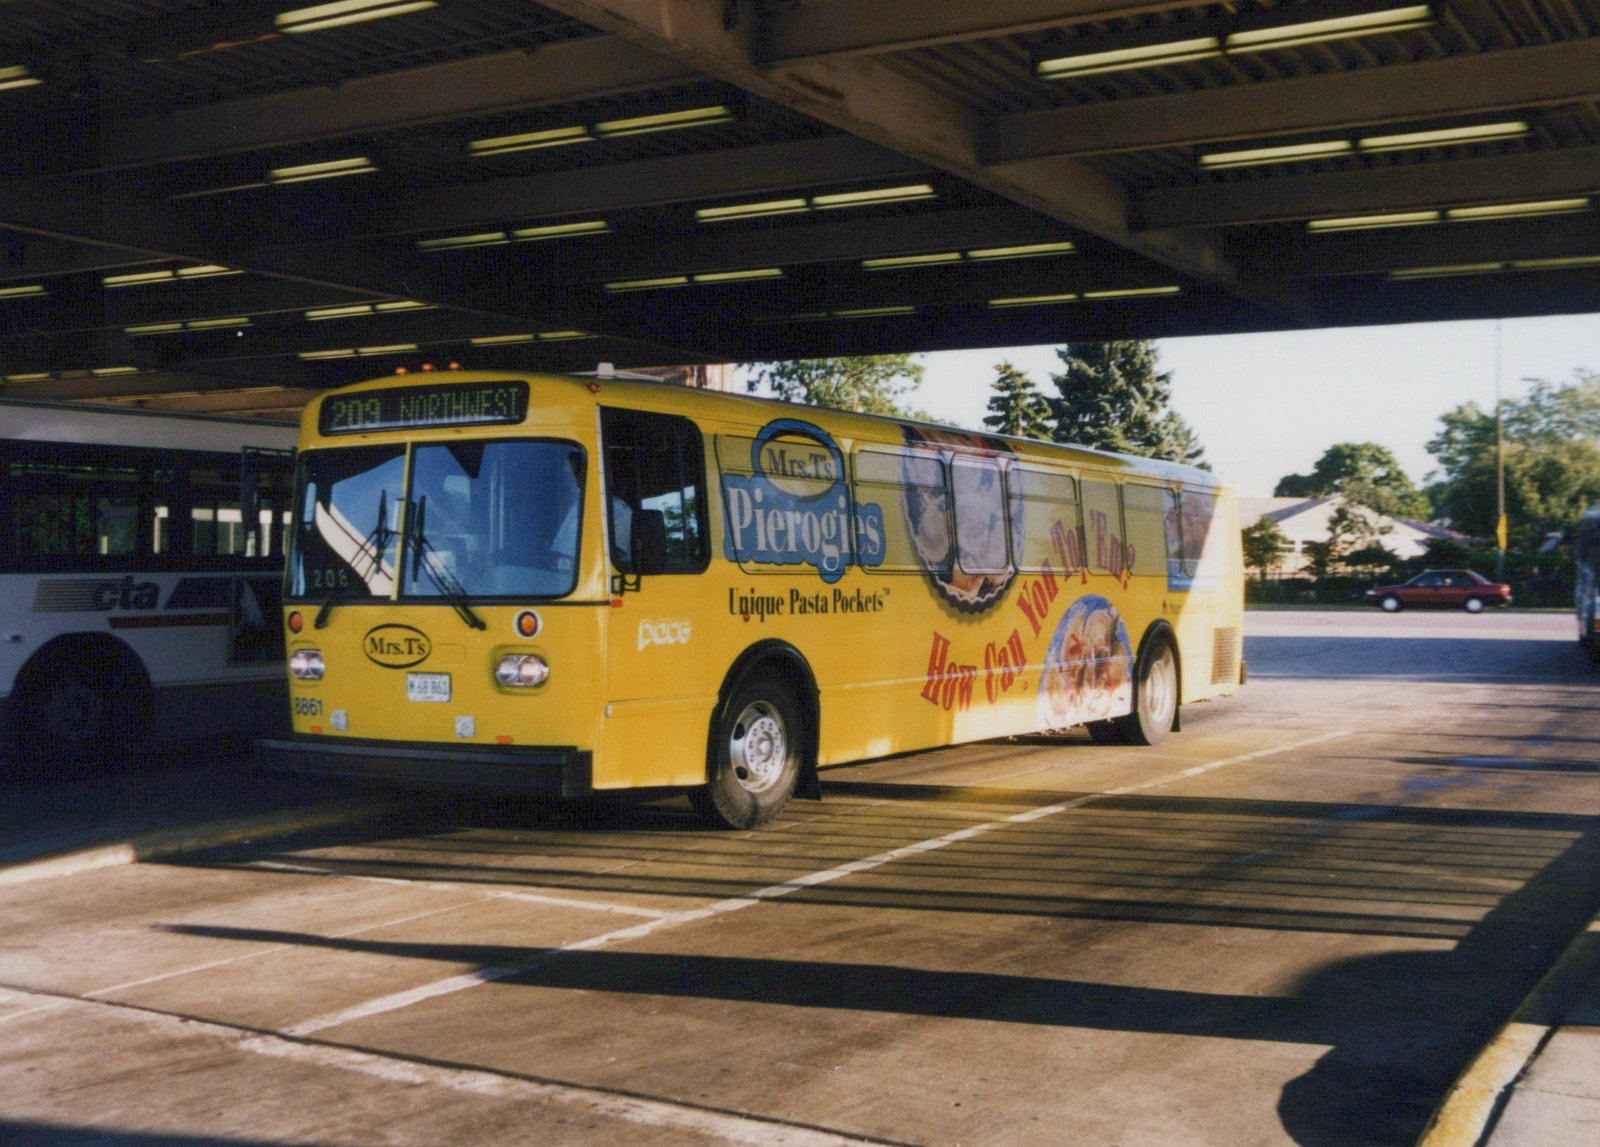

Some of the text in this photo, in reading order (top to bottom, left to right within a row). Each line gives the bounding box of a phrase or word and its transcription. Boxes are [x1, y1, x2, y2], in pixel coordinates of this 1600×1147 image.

[331, 388, 518, 428] 209 NORTHWEST
[727, 487, 880, 572] Pierogies
[94, 575, 159, 612] cta
[729, 588, 785, 623] Unique
[790, 588, 828, 615] Pasta
[637, 619, 692, 651] pace
[921, 631, 978, 712] How
[984, 629, 1027, 705] Can
[1016, 557, 1059, 640] You
[295, 696, 324, 717] 8861
